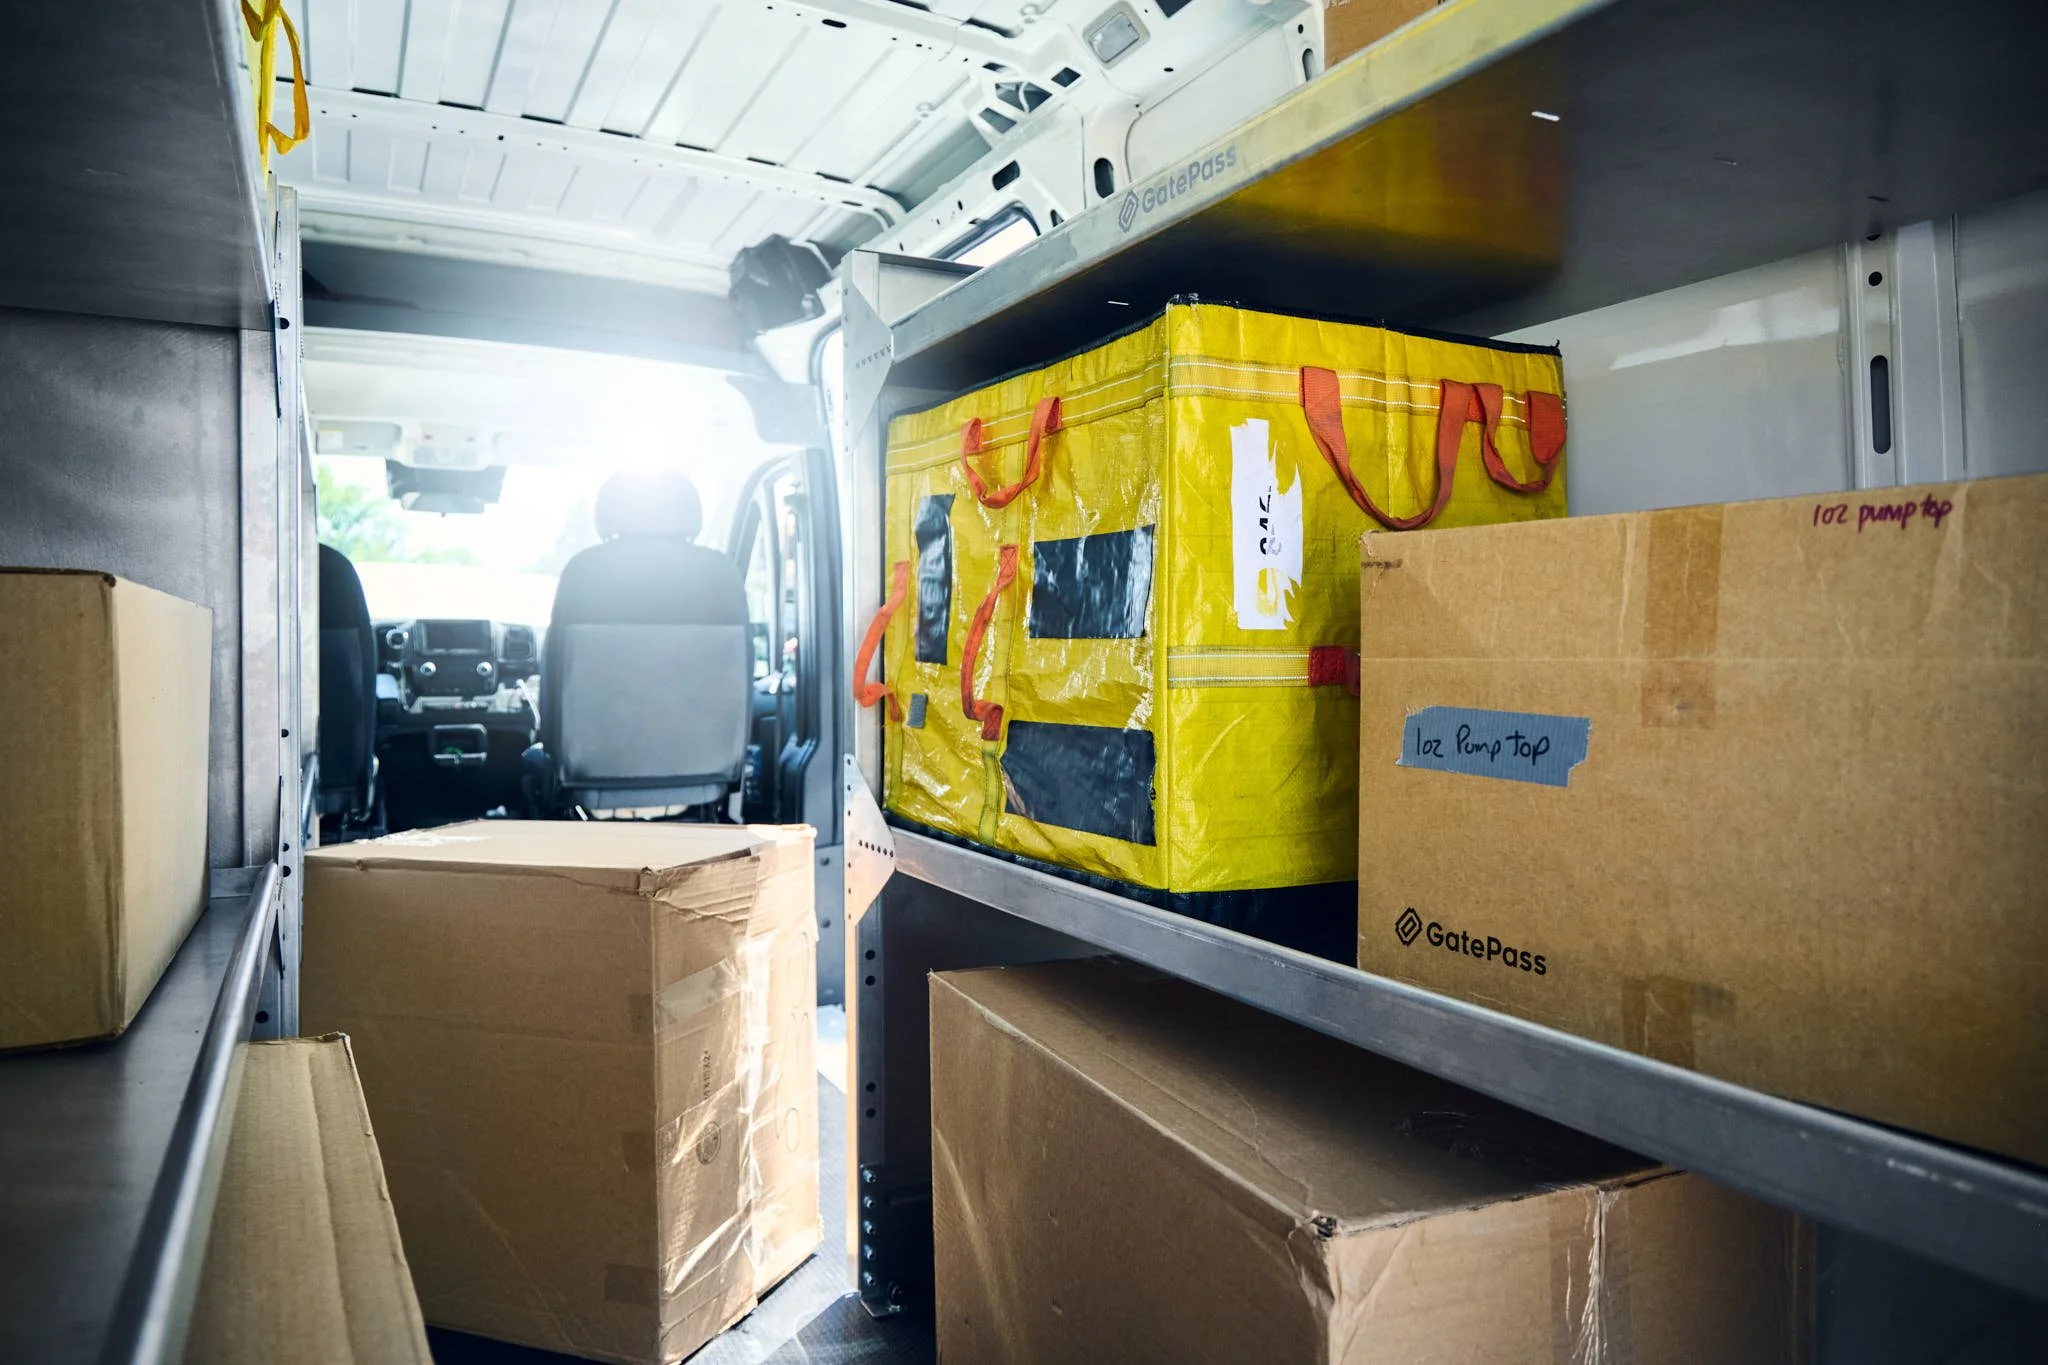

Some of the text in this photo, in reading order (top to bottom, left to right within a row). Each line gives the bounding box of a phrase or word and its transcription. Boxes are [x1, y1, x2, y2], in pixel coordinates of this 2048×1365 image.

[1142, 145, 1237, 214] GatePass
[1857, 500, 1918, 533] pump
[1919, 493, 1954, 529] top
[1426, 921, 1548, 976] GatePass
